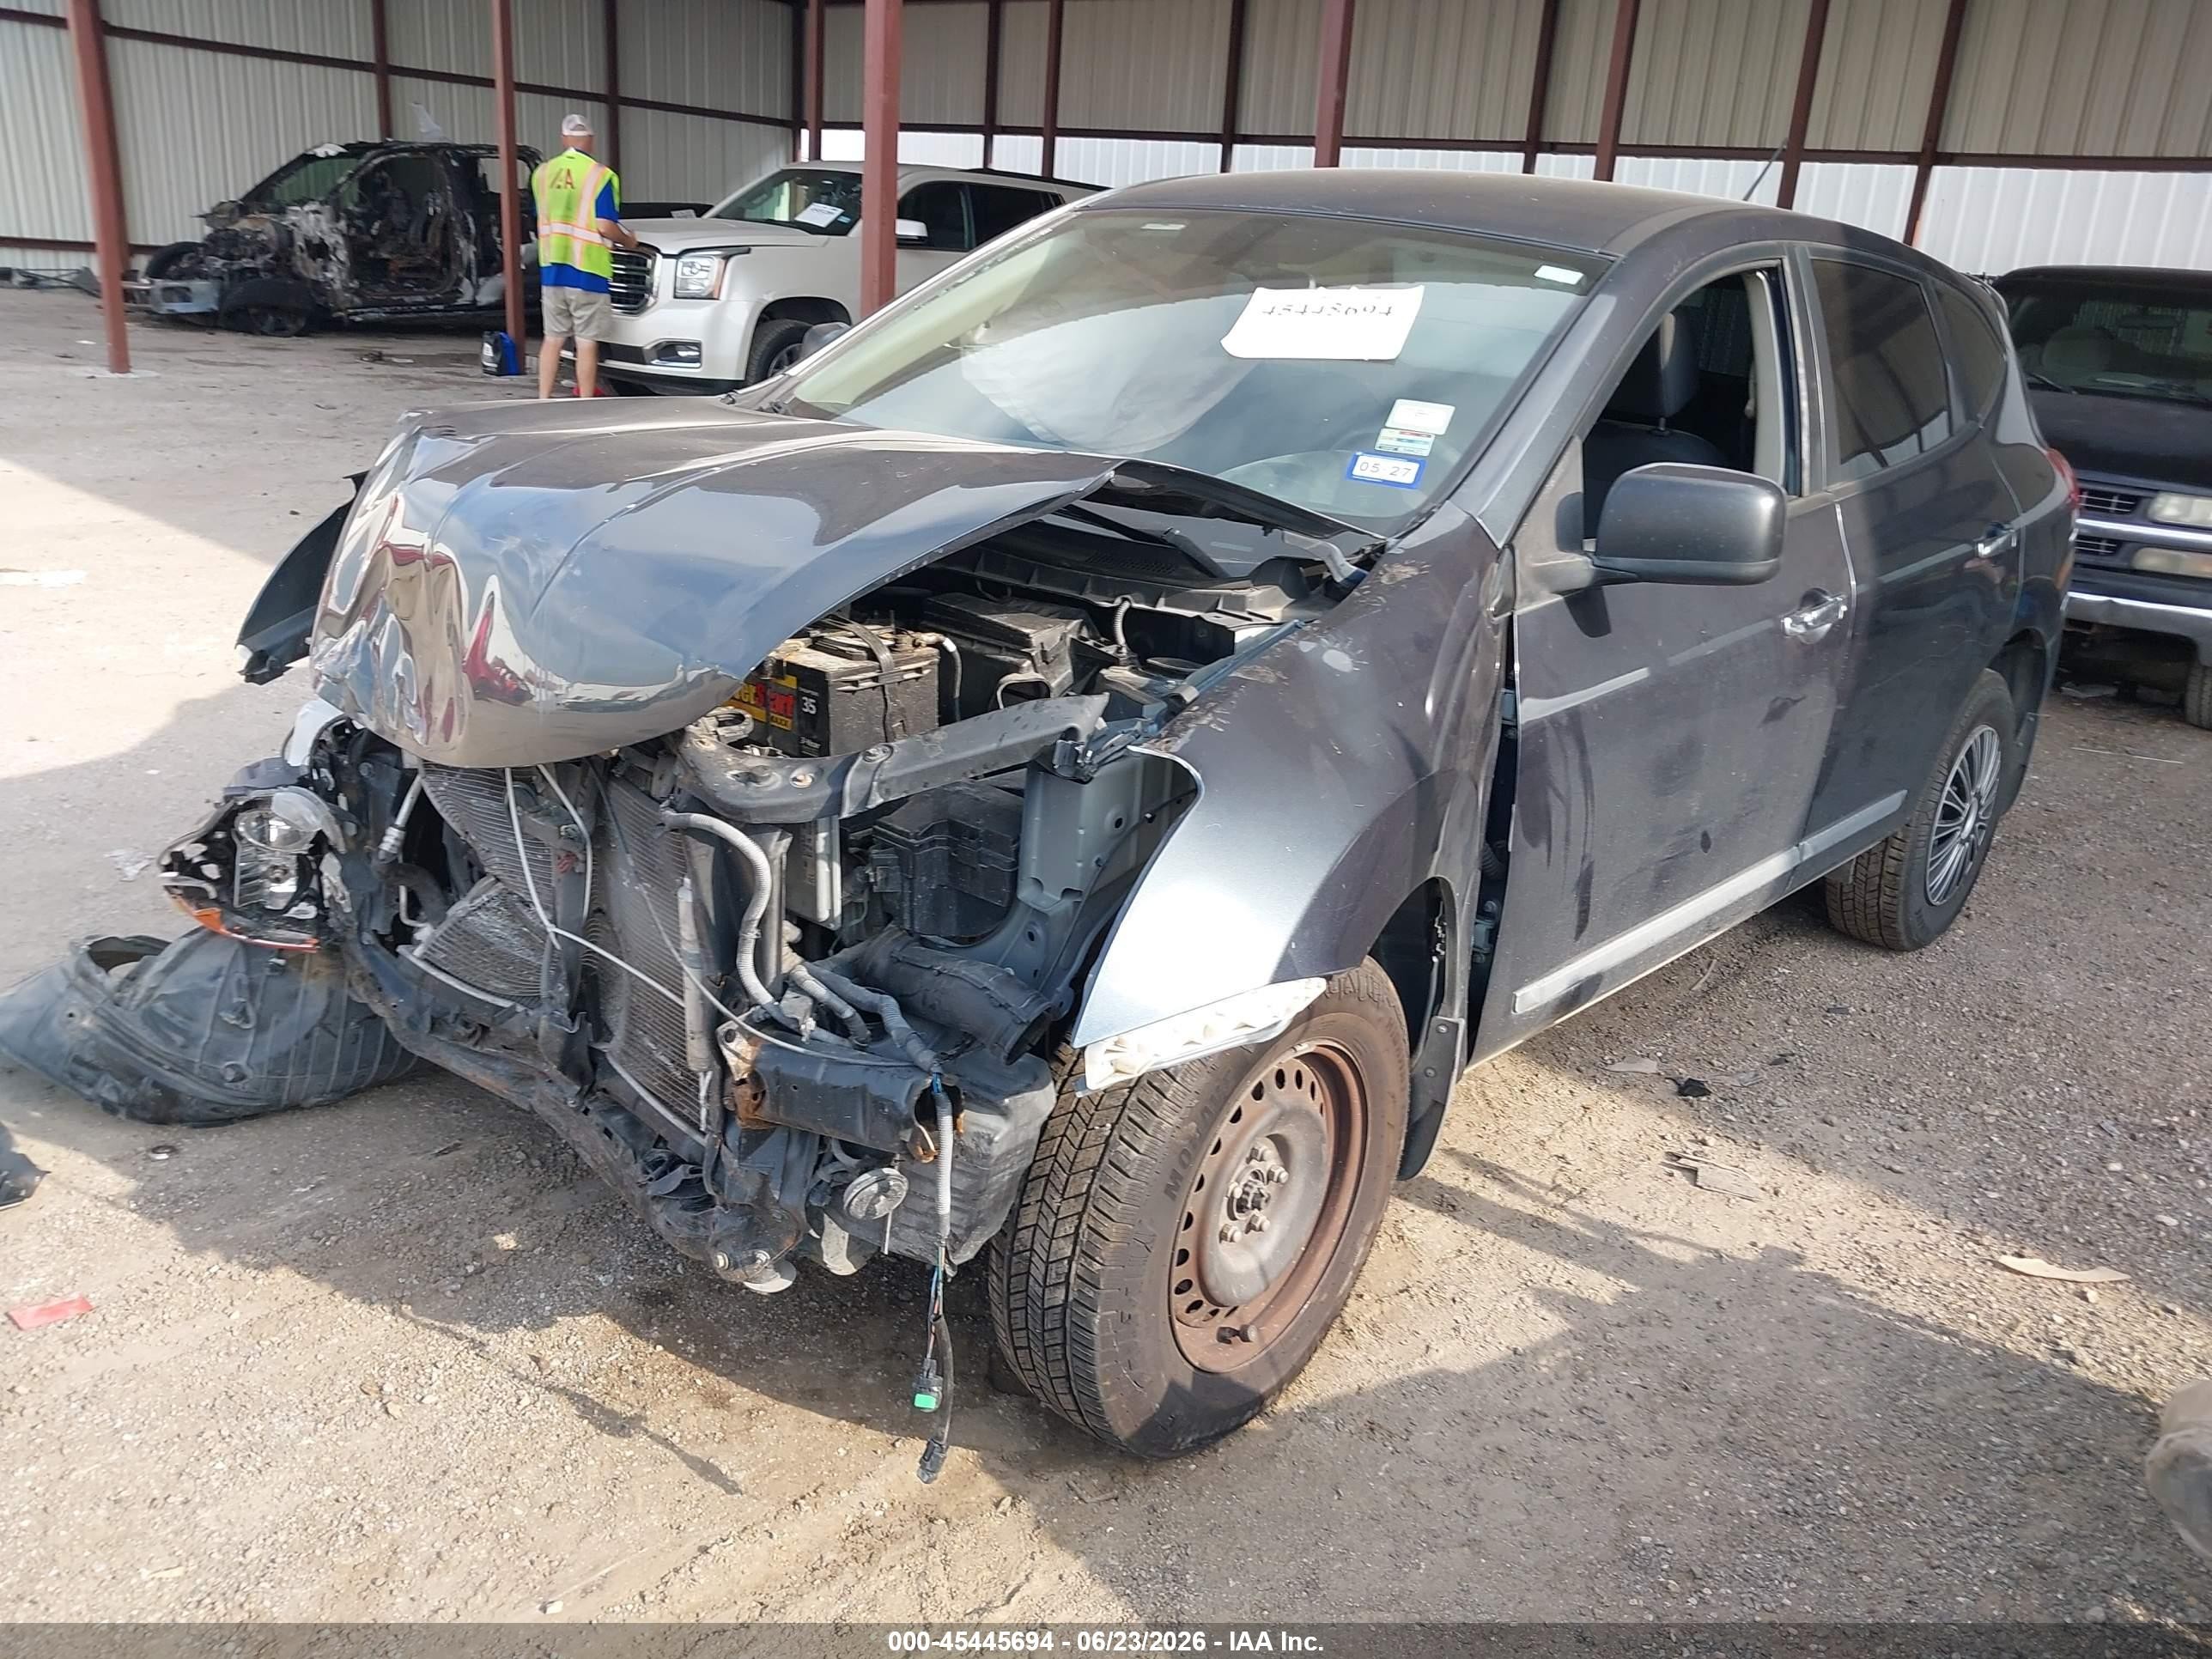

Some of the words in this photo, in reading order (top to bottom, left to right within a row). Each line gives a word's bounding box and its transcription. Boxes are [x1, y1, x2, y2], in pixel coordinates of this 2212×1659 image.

[1359, 460, 1380, 473] 05
[1389, 465, 1413, 477] 27
[801, 696, 817, 715] 35
